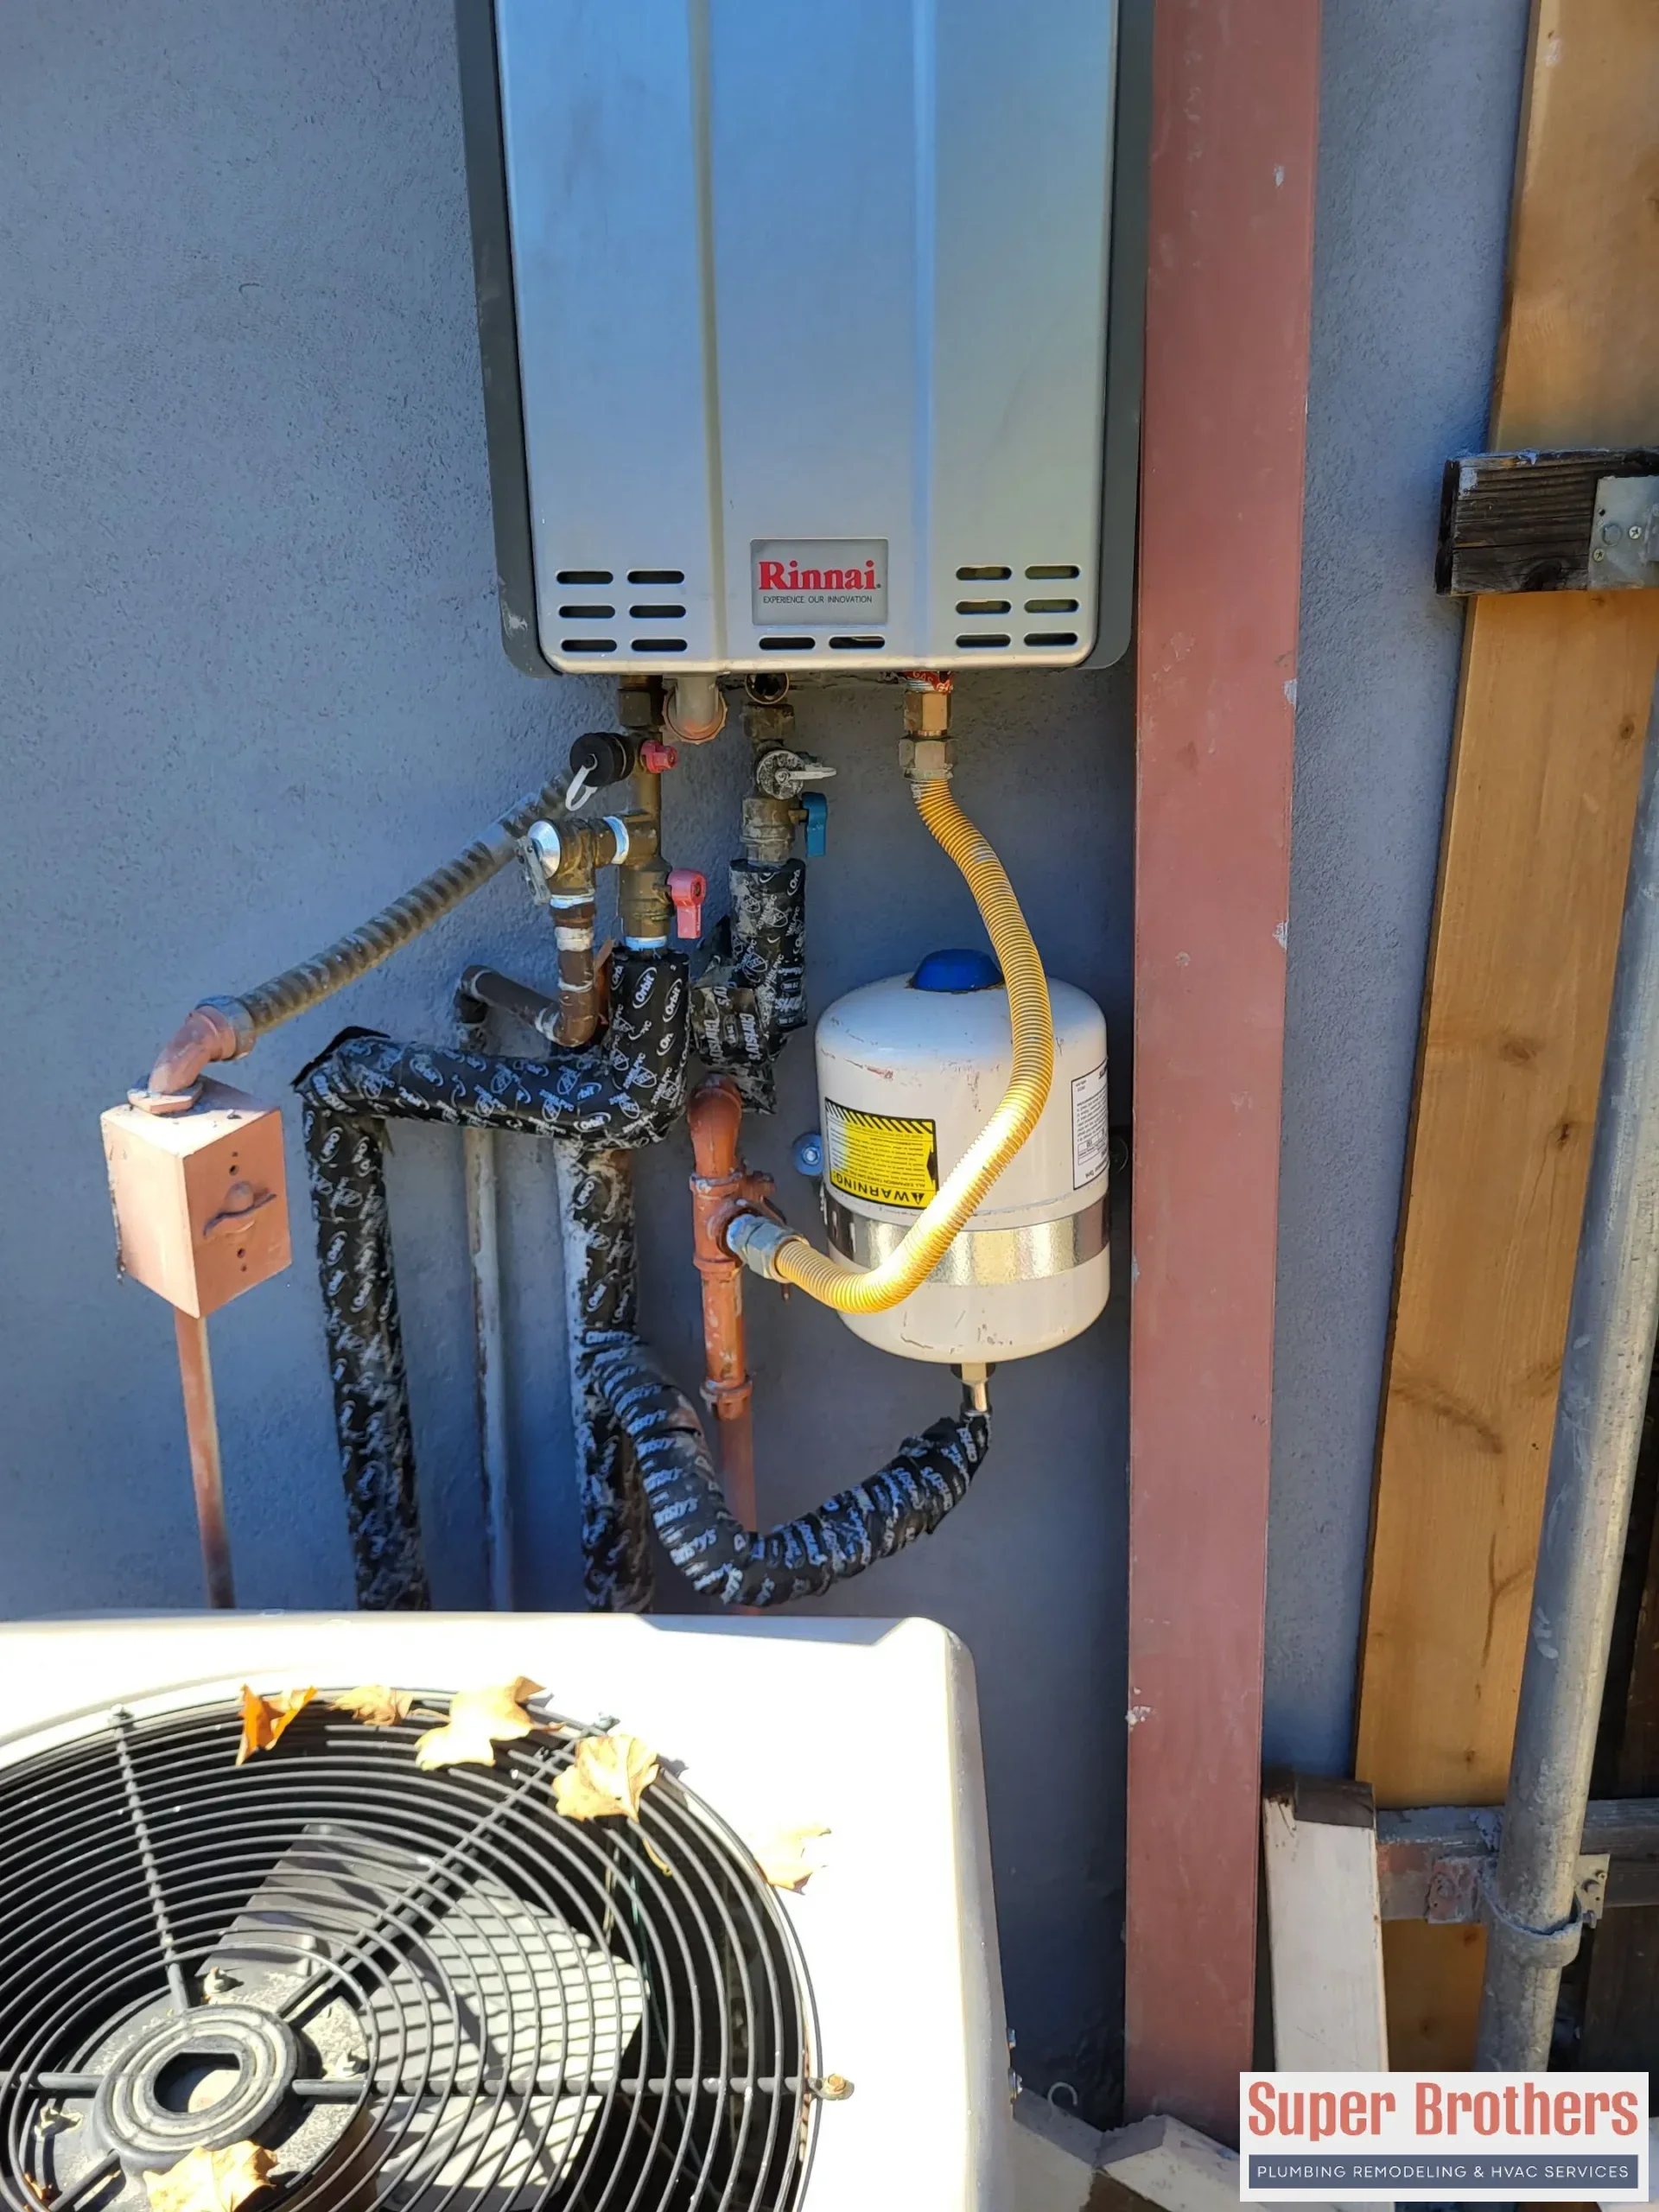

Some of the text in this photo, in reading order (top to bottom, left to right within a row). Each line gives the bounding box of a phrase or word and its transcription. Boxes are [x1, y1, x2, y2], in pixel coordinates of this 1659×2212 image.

[635, 973, 655, 1002] Orbit
[664, 987, 682, 1015] Orbit
[739, 1013, 762, 1061] Christy's
